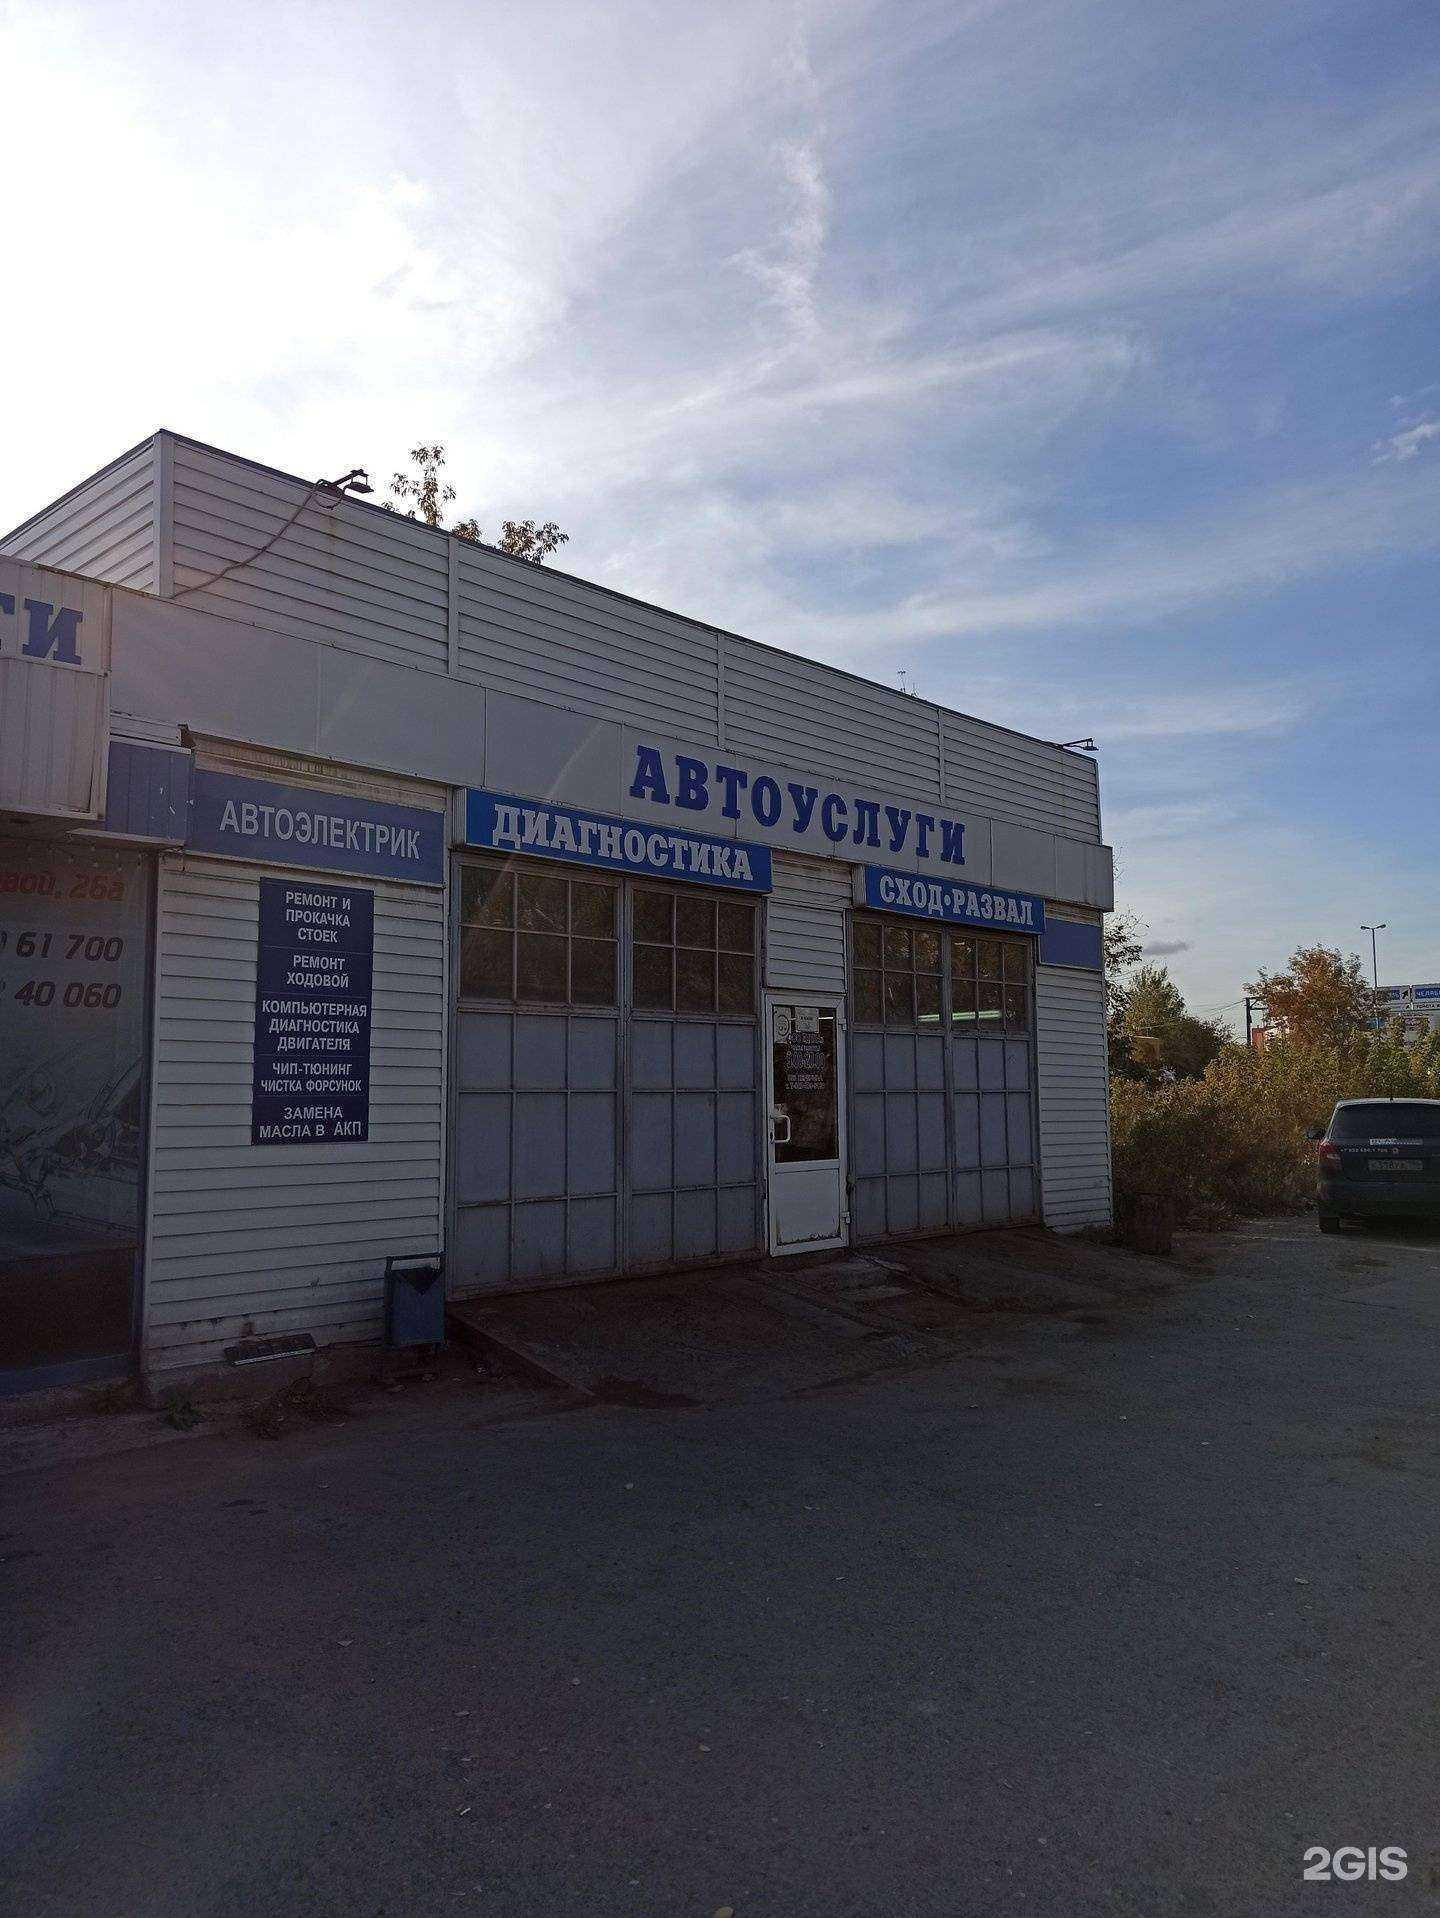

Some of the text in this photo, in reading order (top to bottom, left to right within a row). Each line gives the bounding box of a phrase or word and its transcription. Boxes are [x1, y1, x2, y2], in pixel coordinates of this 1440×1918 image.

[629, 744, 966, 865] АВТОУСЛУГИ
[219, 800, 421, 859] АВТОЭЛЕКТРИК
[492, 804, 753, 881] ДИАГНОСТИКА
[285, 891, 351, 910] РЕМОНТ И
[286, 909, 350, 927] ПРОКАЧКА
[298, 928, 338, 943] СТОЕК
[16, 932, 52, 958] 61
[65, 934, 124, 962] 700
[293, 955, 346, 970] РЕМОНТ
[286, 972, 349, 988] ХОДОВОЙ
[15, 981, 122, 1008] 40 060
[262, 1000, 367, 1017] КОМПЬЮТЕРНАЯ
[269, 1019, 360, 1034] ДИАГНОСТИКА
[278, 1036, 351, 1051] ДВИГАТЕЛЯ
[272, 1063, 352, 1075] ЧИП-ТЮНИНГ
[261, 1079, 362, 1092] ЧИСТКА ФОРСУНОК
[284, 1106, 343, 1120] ЗАМЕНА
[259, 1121, 362, 1138] МАСЛА В АКП
